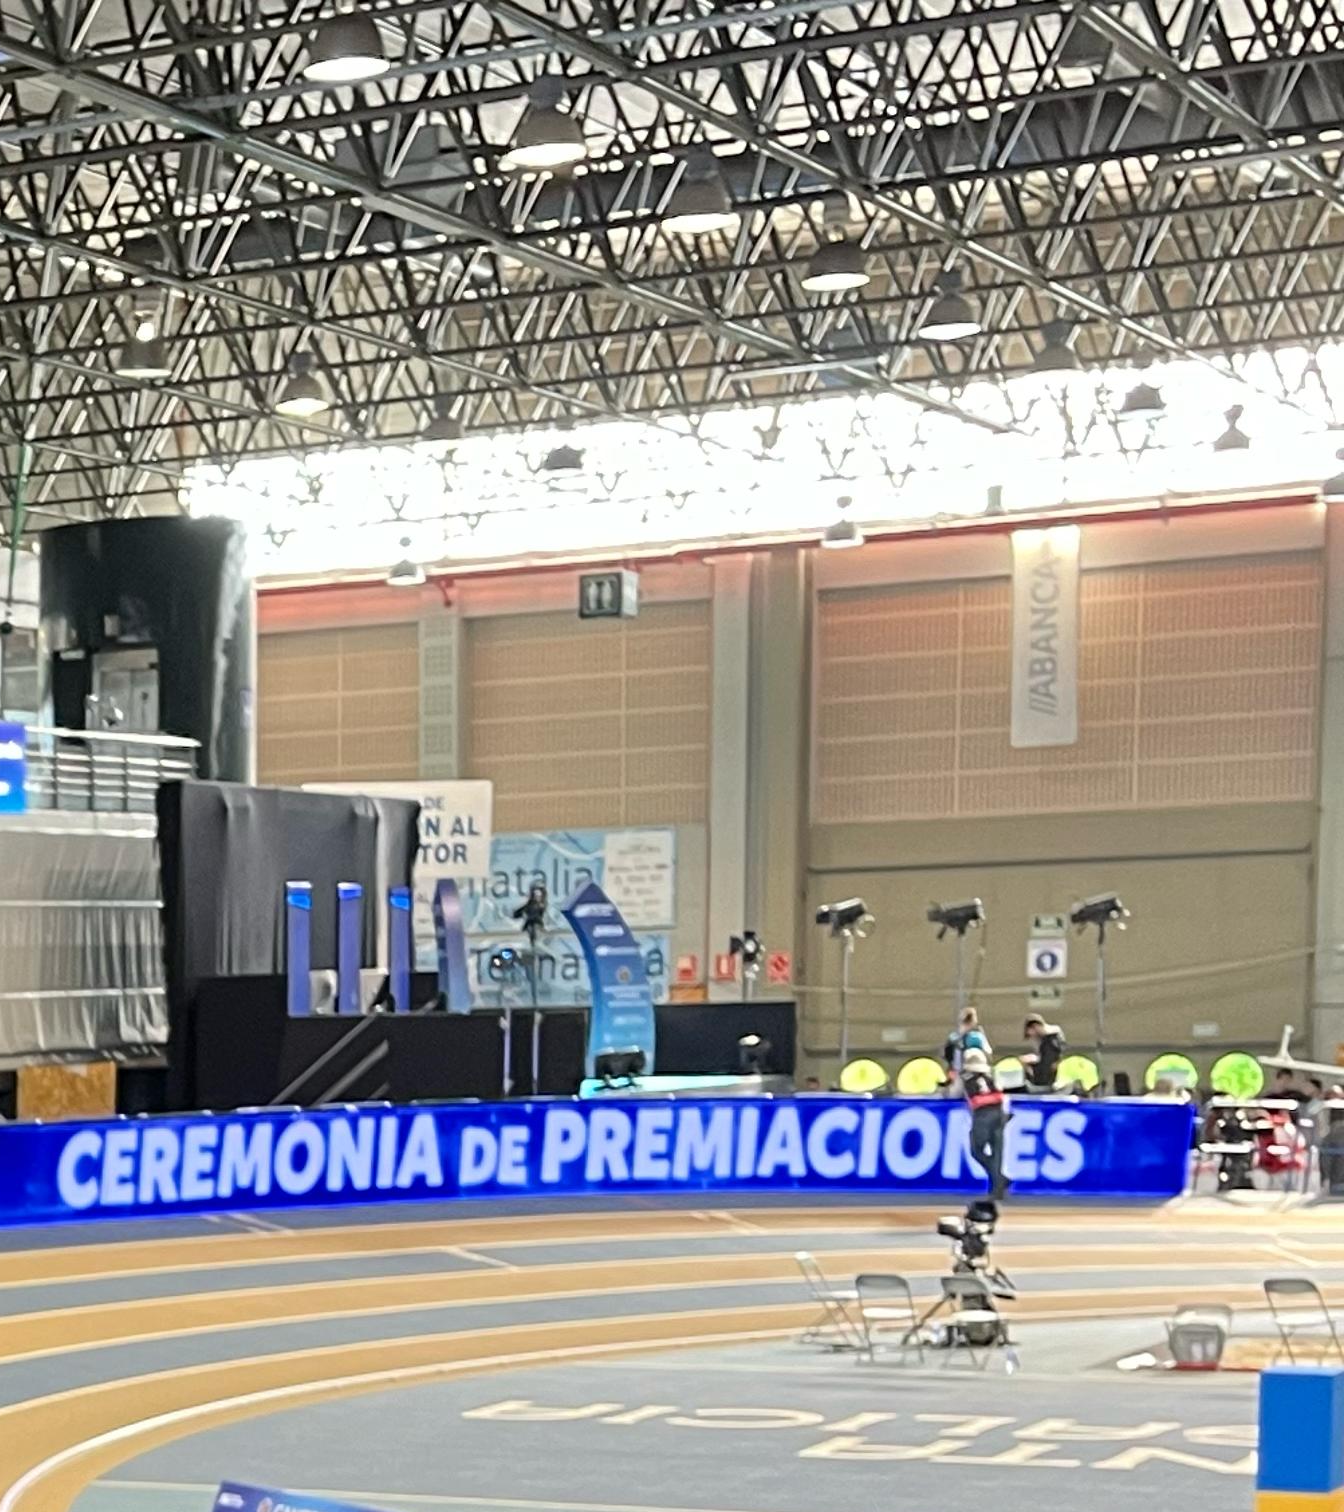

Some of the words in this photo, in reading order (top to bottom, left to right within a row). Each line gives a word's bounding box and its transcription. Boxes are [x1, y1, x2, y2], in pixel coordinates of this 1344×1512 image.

[450, 815, 481, 836] AL
[57, 1113, 444, 1209] CEREMONIA
[459, 1126, 530, 1187] DE
